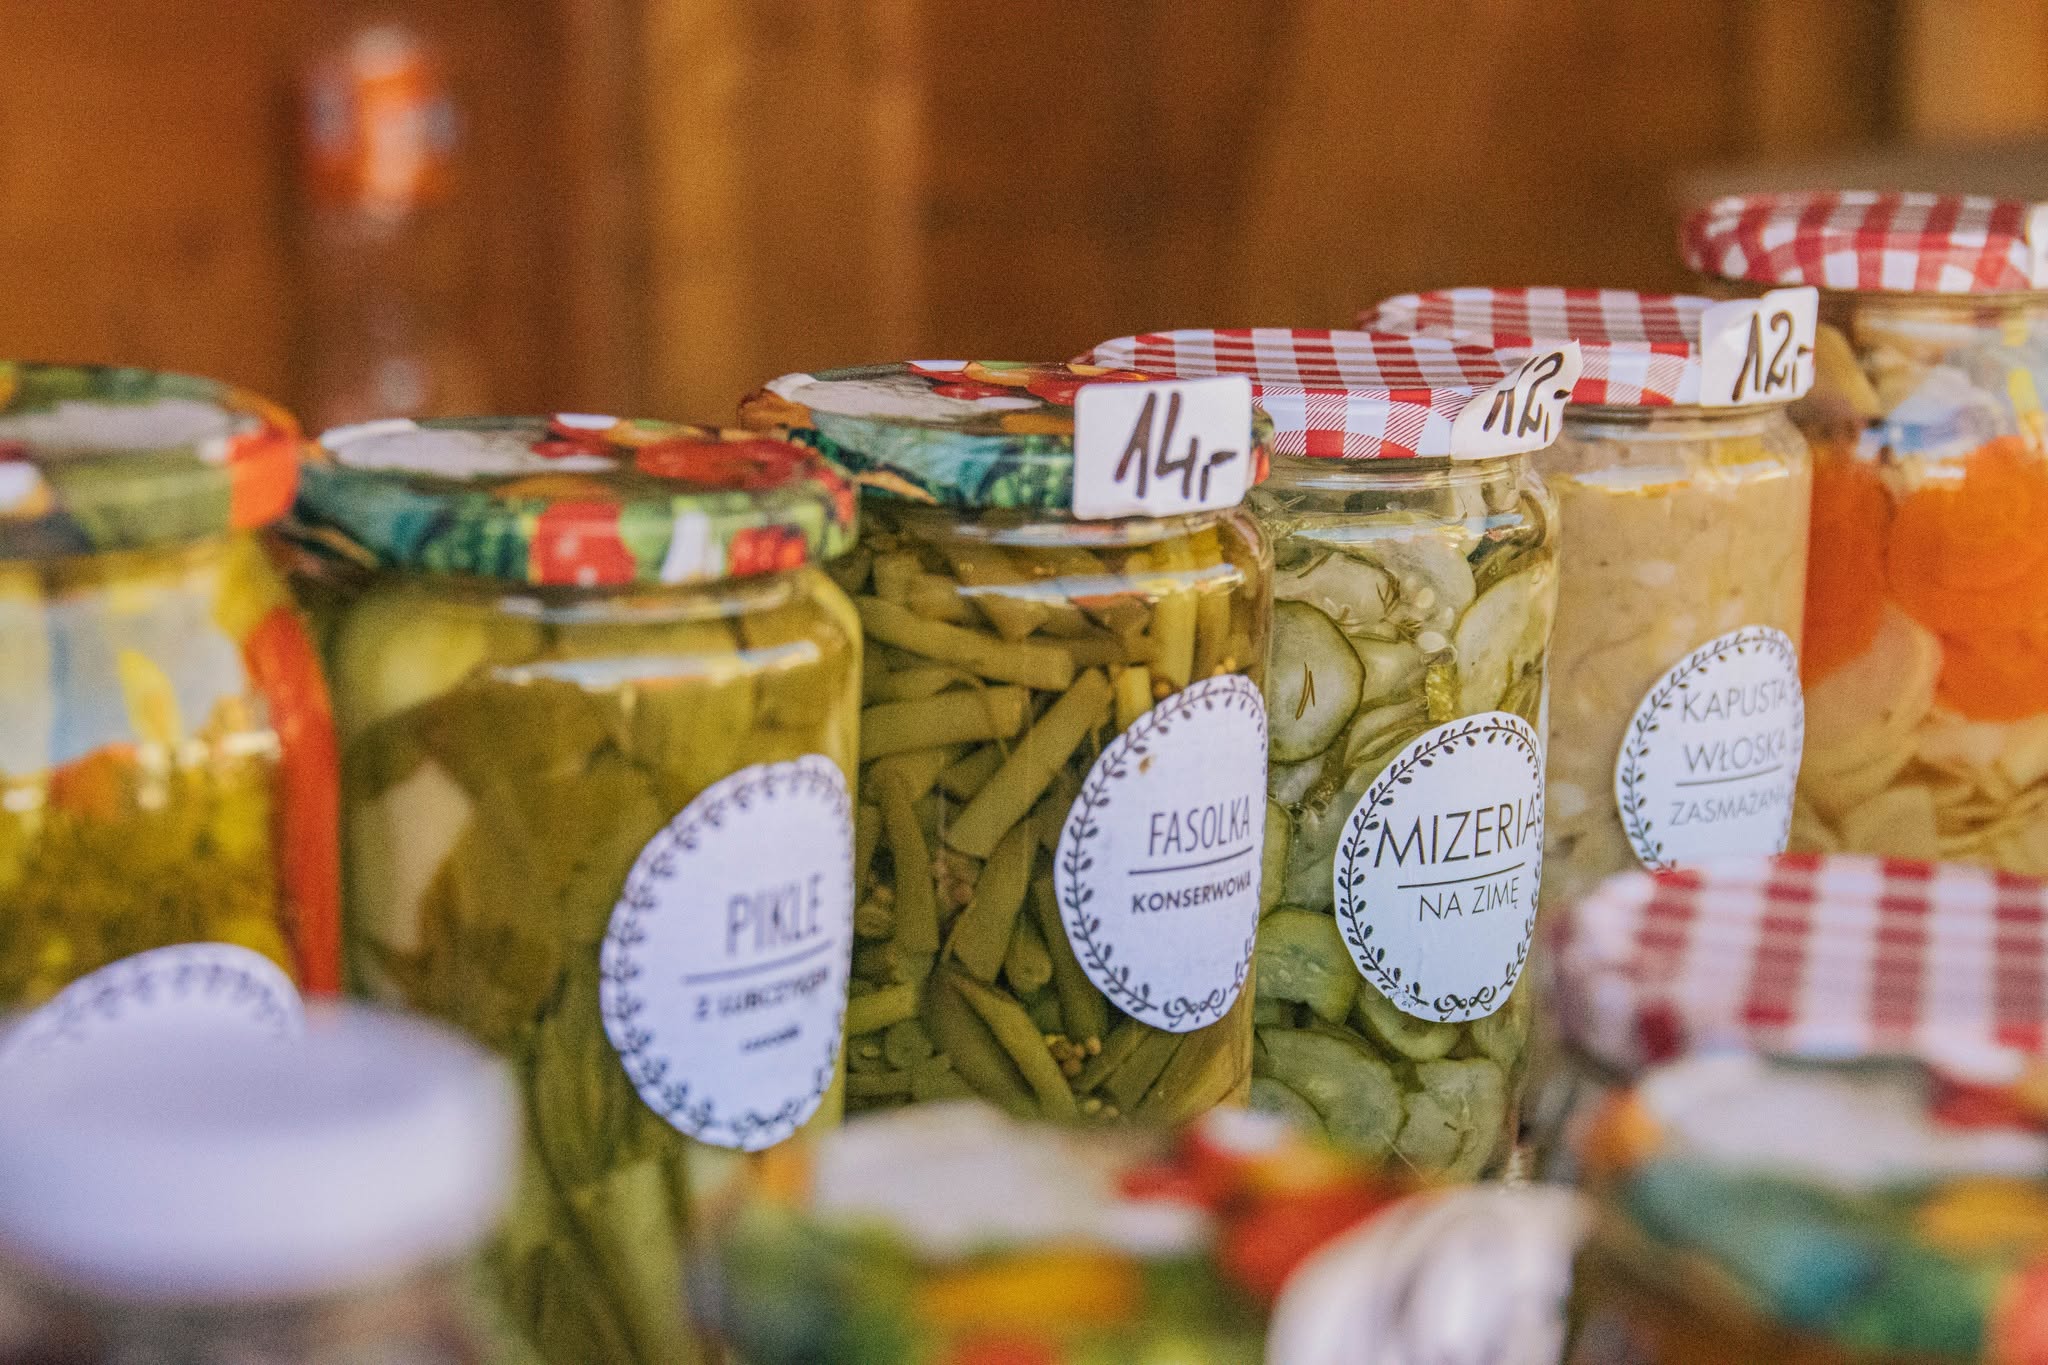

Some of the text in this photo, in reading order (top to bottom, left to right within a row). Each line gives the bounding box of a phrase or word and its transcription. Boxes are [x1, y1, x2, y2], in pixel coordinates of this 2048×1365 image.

[1148, 795, 1250, 857] FASOLKA
[1374, 793, 1537, 868] MIZERIA
[726, 872, 824, 957] PIKLE
[1419, 876, 1520, 922] NA ZIMĘ
